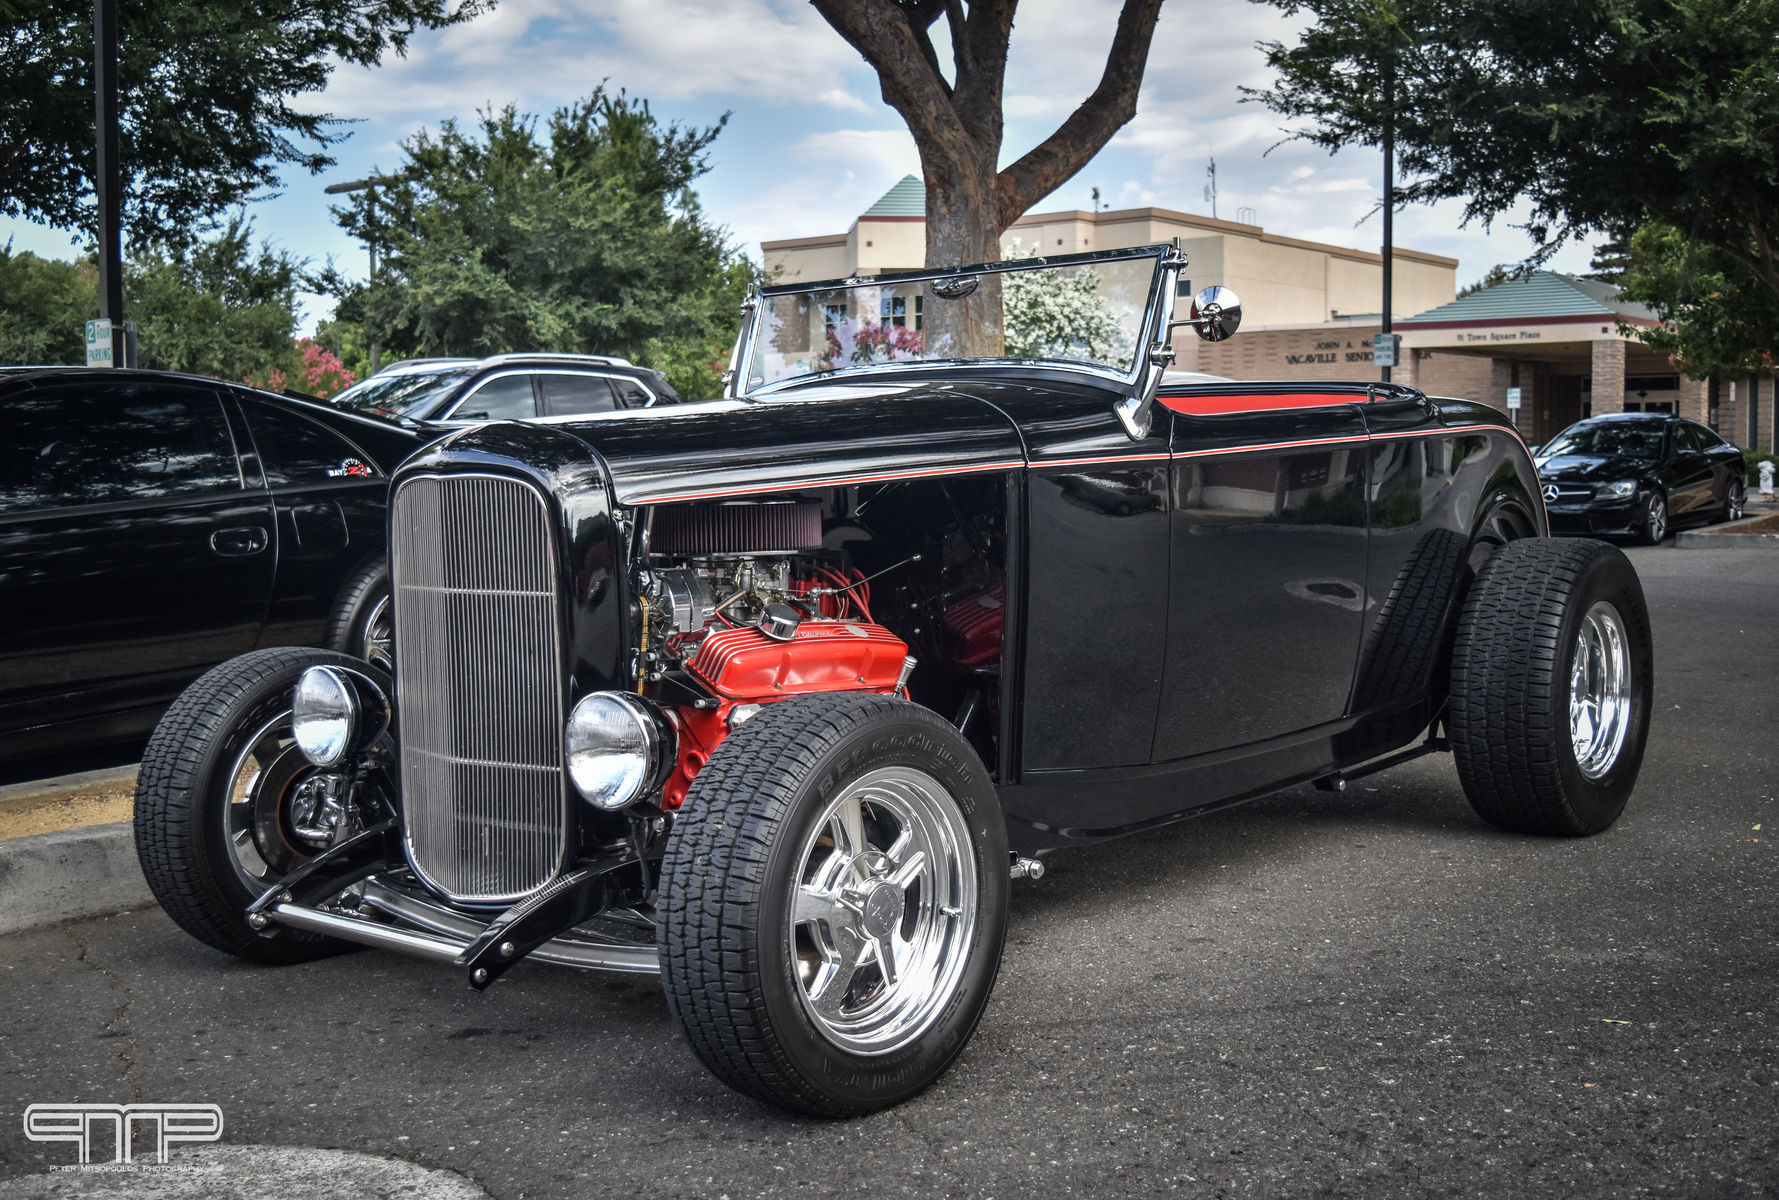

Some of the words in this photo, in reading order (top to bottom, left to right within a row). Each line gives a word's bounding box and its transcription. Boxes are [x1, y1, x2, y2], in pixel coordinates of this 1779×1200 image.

[88, 325, 95, 341] 2
[97, 327, 110, 339] HOUR
[1467, 333, 1487, 341] Town
[1490, 332, 1516, 342] Square
[1520, 331, 1541, 340] Place
[1314, 341, 1340, 350] JOHN
[89, 347, 111, 361] PARKING
[1285, 353, 1337, 365] VACAVILLE
[1345, 352, 1374, 362] SENIO
